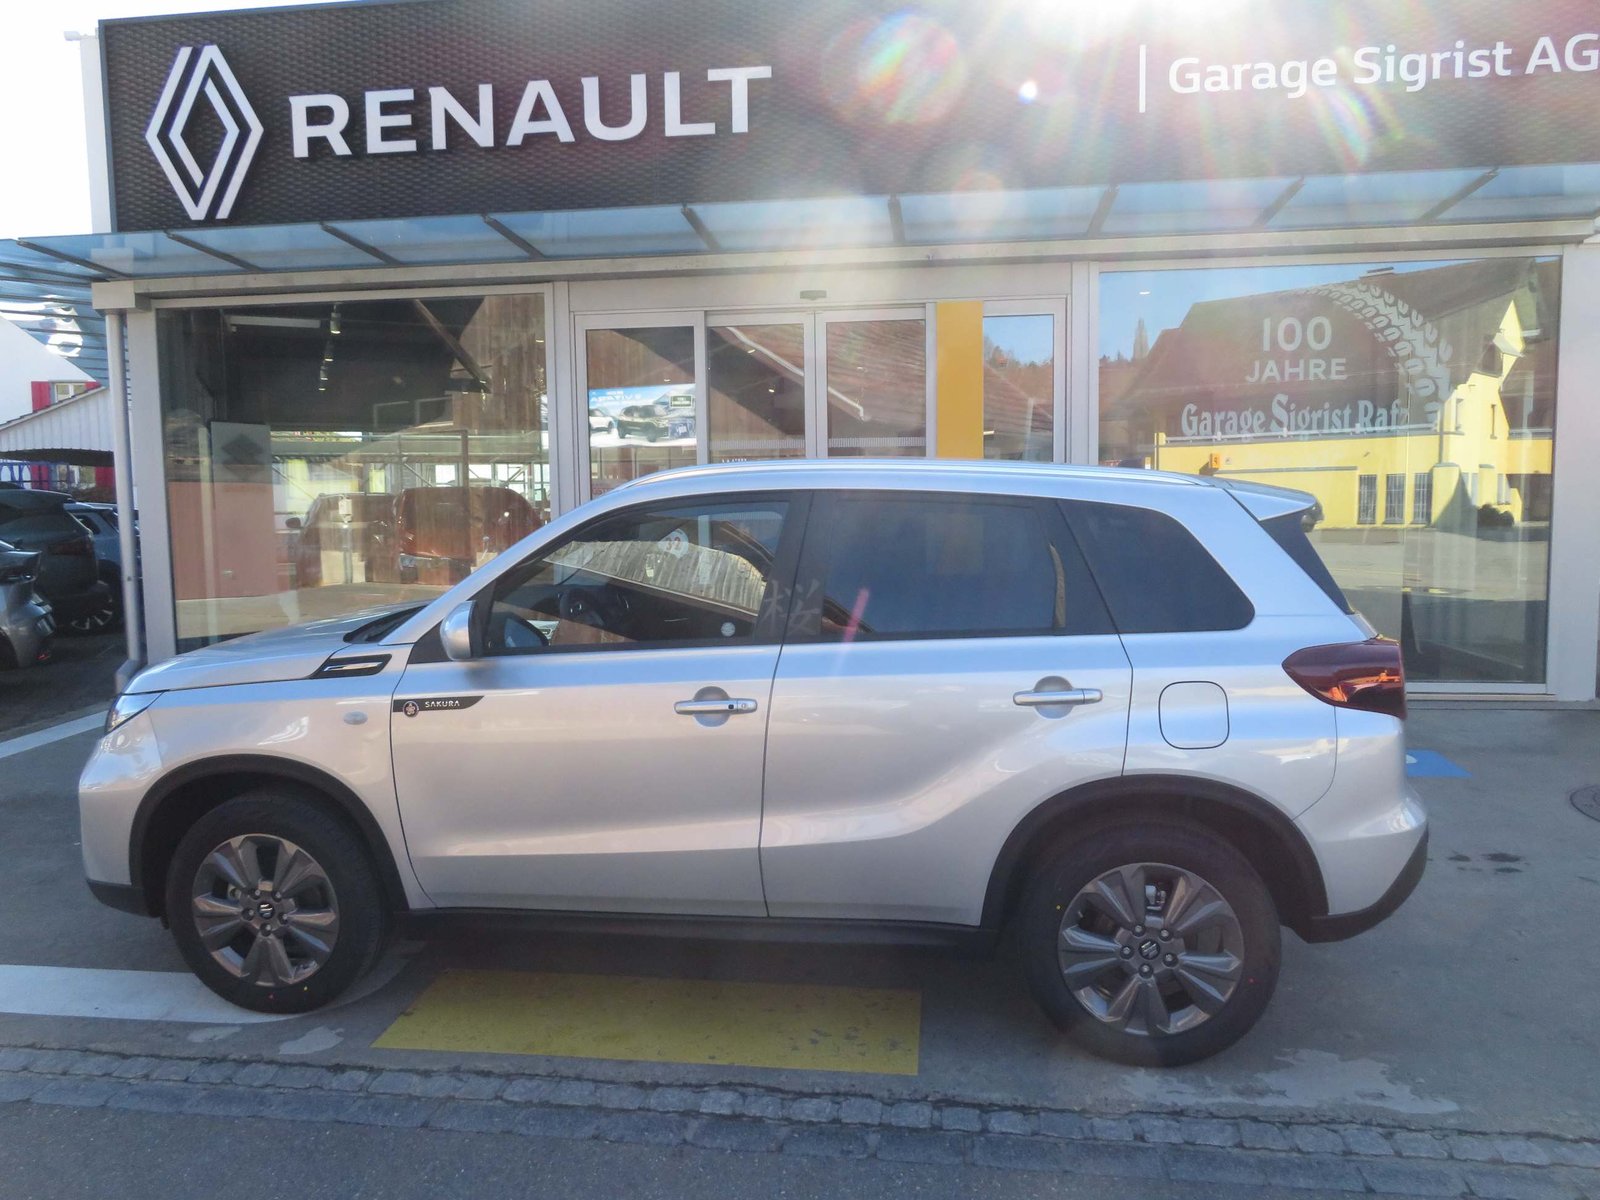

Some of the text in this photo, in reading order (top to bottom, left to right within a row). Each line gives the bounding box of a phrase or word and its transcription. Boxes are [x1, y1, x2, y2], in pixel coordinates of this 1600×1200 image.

[1168, 33, 1599, 98] Garage Sigrist AG
[288, 65, 773, 158] RENAULT
[1262, 315, 1332, 352] 100
[1245, 358, 1347, 384] JAHRE
[1181, 402, 1266, 442] Garage
[1270, 393, 1352, 441] Sigrist
[424, 699, 461, 709] SAKURA
